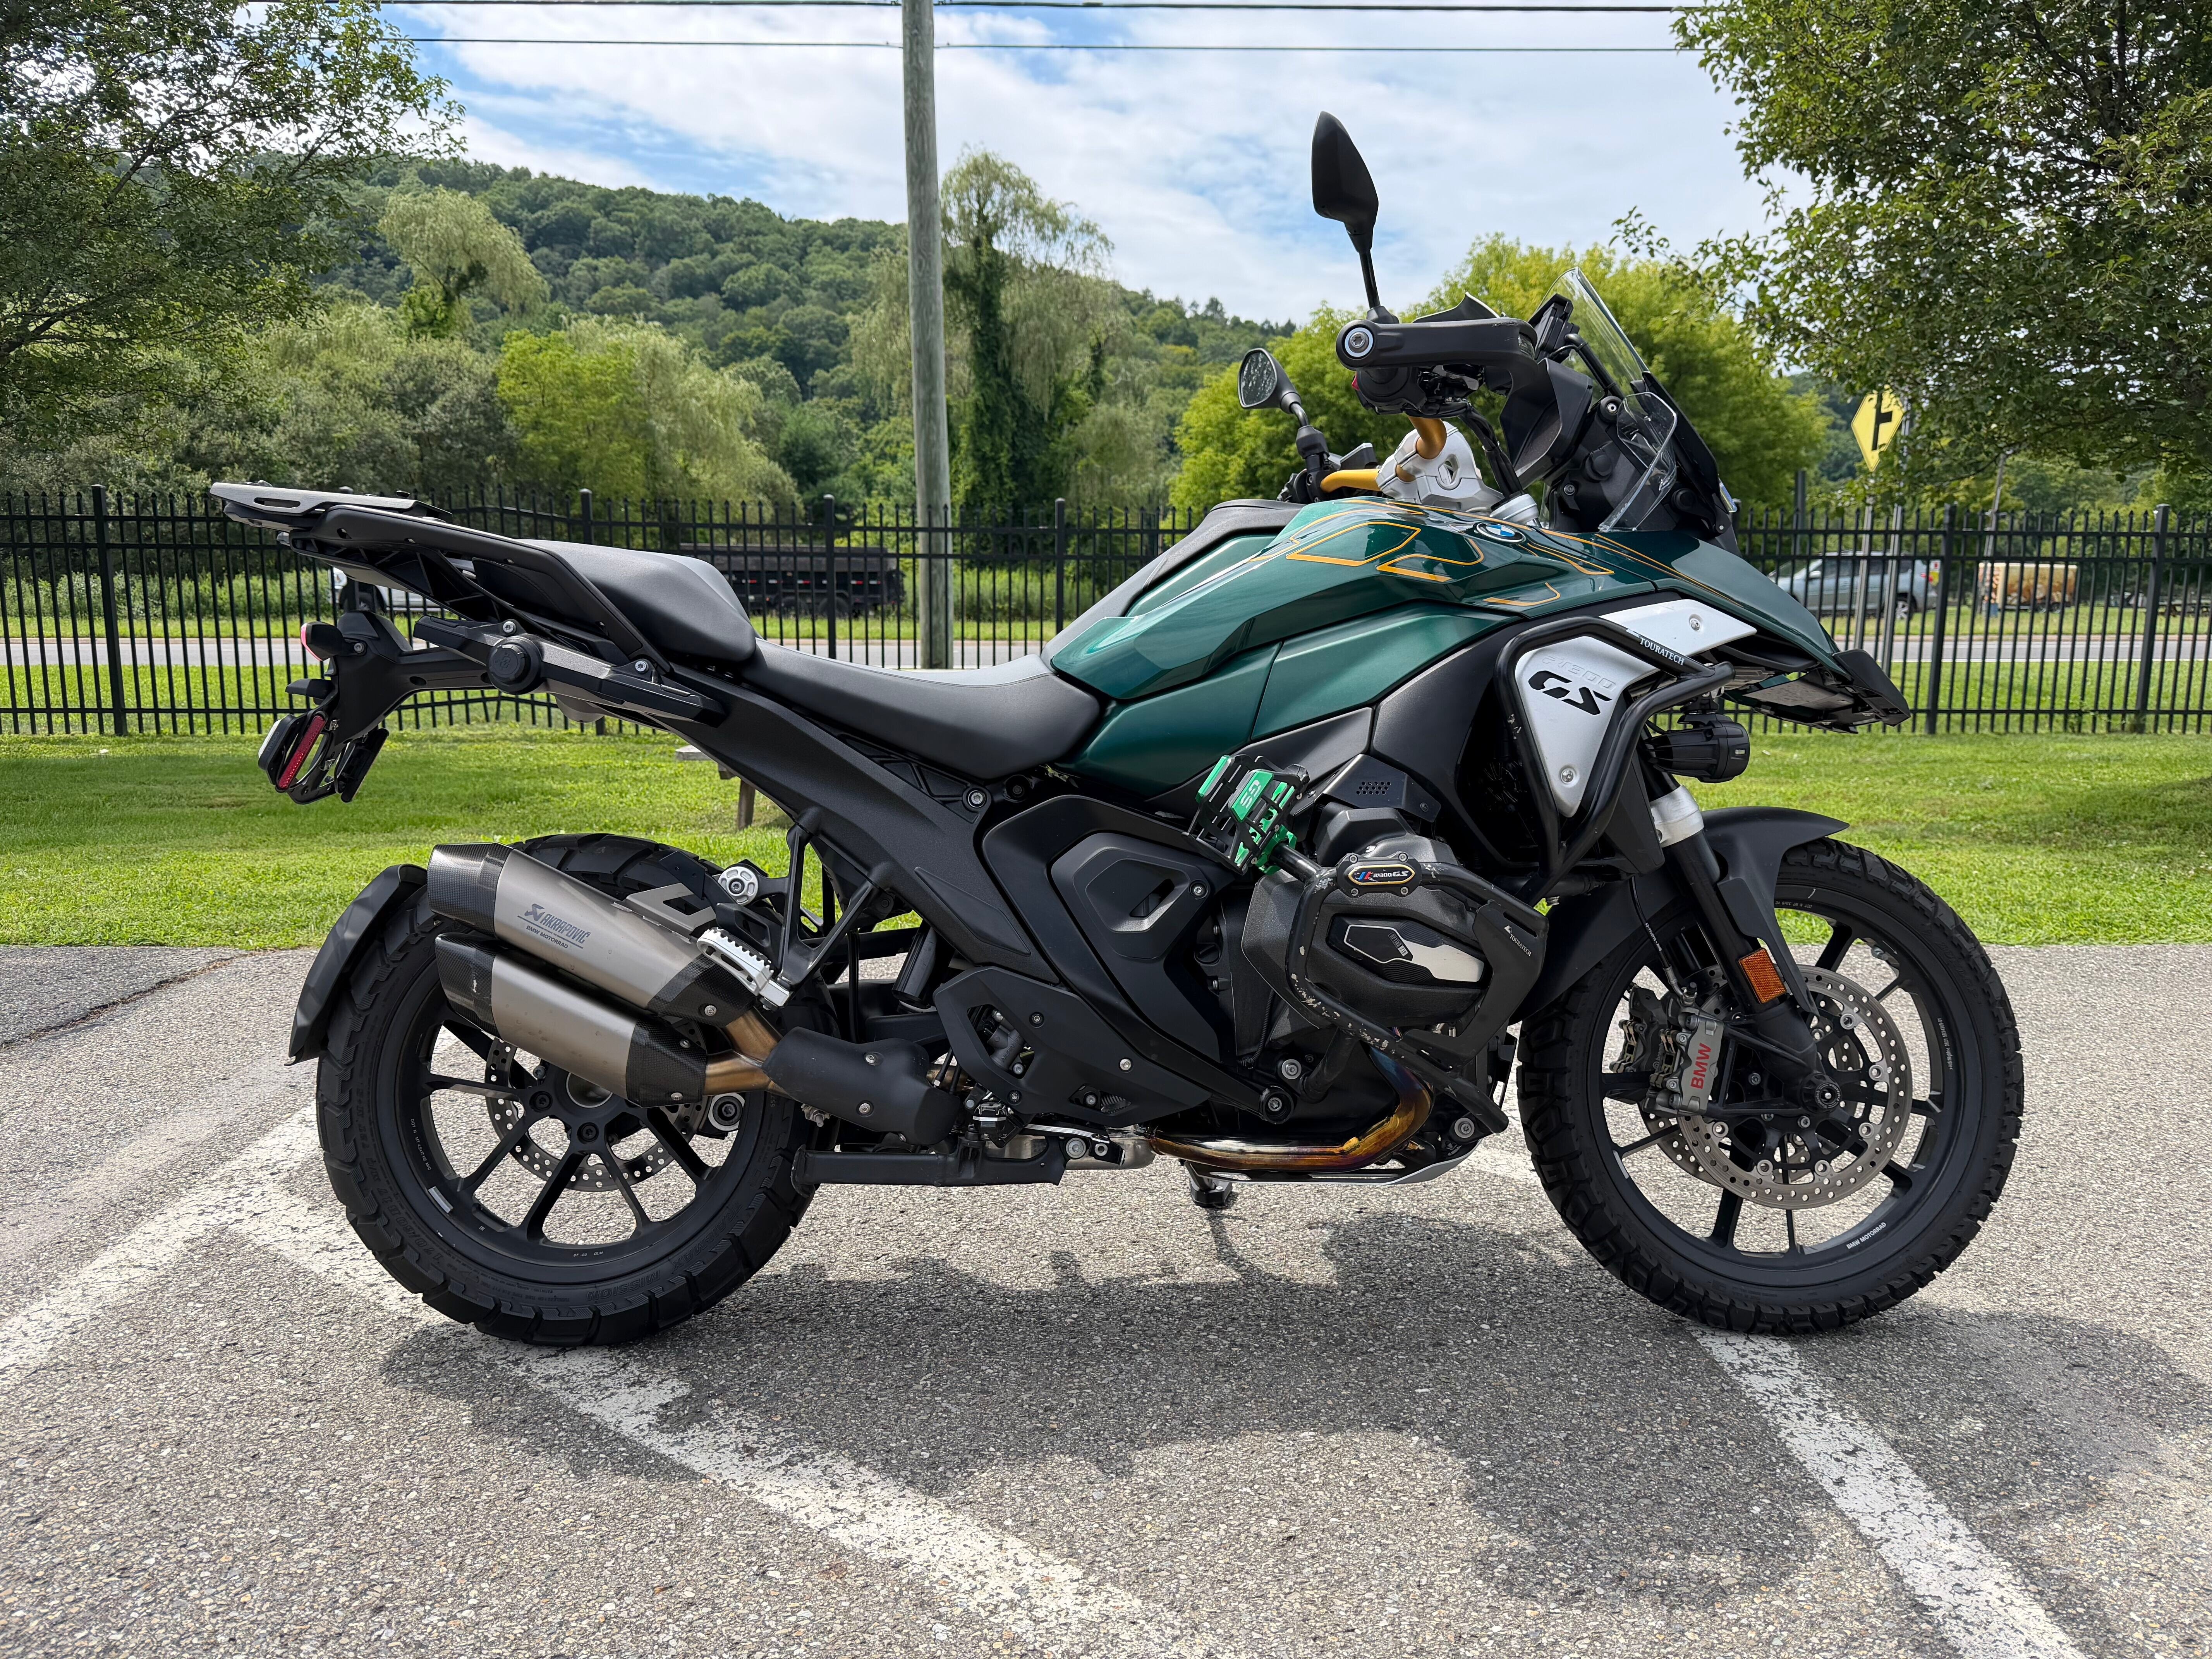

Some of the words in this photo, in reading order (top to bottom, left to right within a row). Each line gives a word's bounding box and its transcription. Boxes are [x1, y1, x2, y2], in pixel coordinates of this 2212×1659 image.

[1640, 637, 1685, 666] TOURATECH
[1528, 670, 1612, 715] GS
[1240, 780, 1261, 809] GS
[526, 925, 540, 934] BMW
[540, 932, 568, 948] MOTORRAD
[1510, 934, 1532, 957] TOURATECH
[1691, 1042, 1712, 1089] BMW
[1846, 1239, 1860, 1249] BMW
[1860, 1222, 1887, 1242] MOTORRAD
